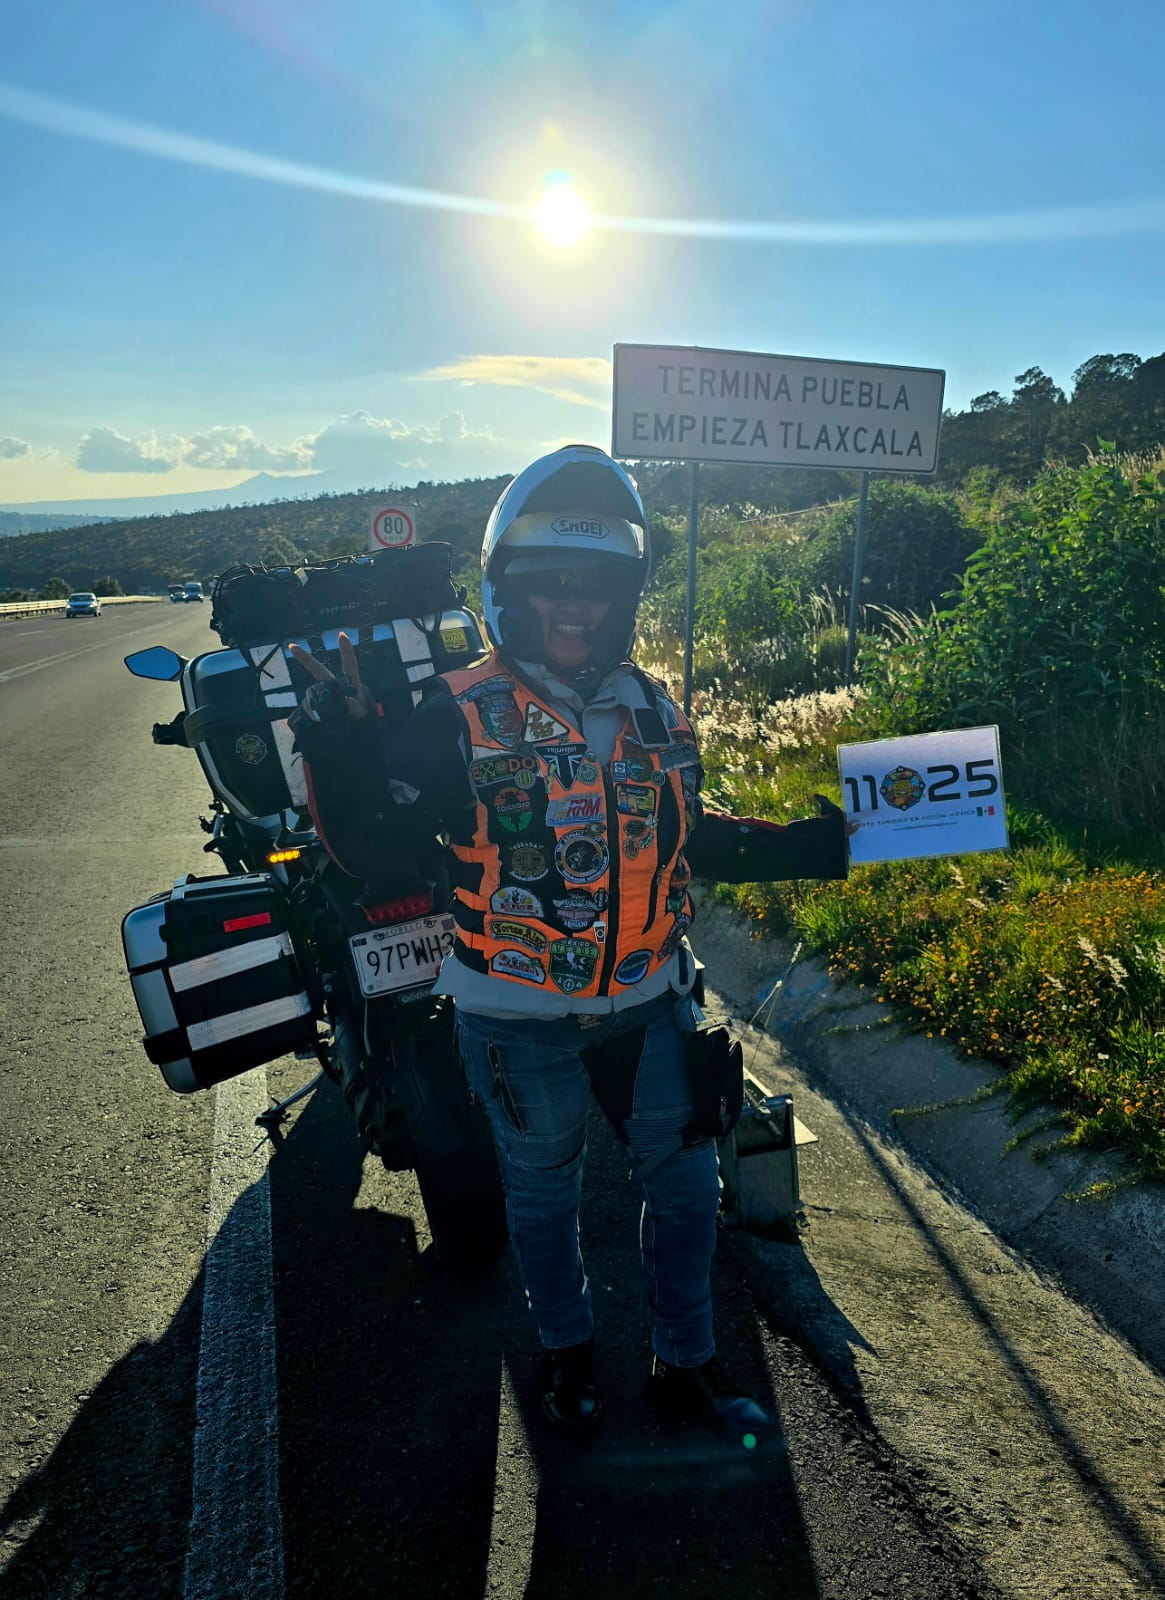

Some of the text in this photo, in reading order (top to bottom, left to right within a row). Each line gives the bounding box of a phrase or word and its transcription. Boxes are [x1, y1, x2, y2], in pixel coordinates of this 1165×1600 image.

[658, 365, 910, 411] TERMINA PUEBLA
[632, 412, 922, 457] EMPIEZA TLAXCALA
[384, 516, 403, 534] 80
[559, 519, 602, 536] SHOEI
[546, 746, 577, 754] TRIUMPH
[383, 922, 423, 937] MORELO
